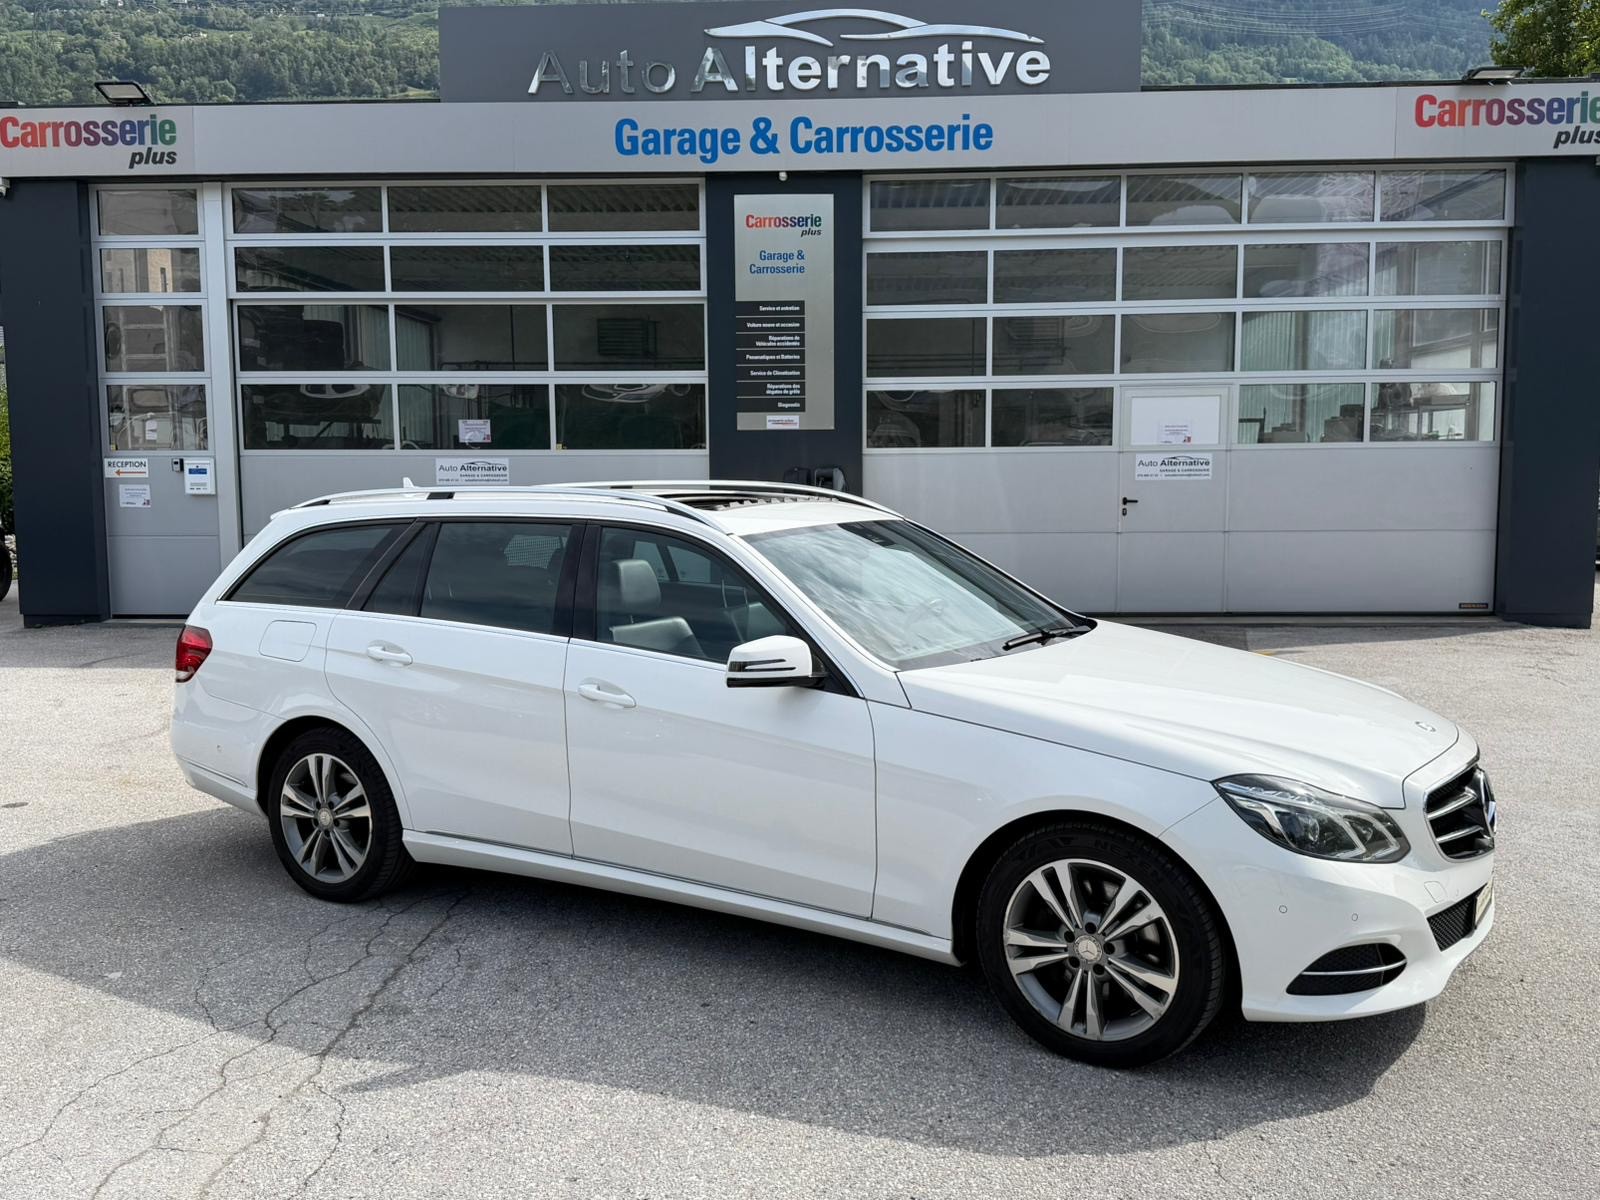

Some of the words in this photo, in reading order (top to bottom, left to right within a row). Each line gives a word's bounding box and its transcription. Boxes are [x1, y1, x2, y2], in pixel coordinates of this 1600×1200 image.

[527, 49, 676, 95] Auto
[690, 40, 1051, 92] Alternative
[0, 114, 177, 148] Carrosserie
[615, 118, 742, 164] Garage
[750, 117, 780, 154] &
[789, 113, 994, 155] Carrosserie
[128, 147, 178, 169] plus
[746, 214, 822, 228] Carrosserie
[801, 228, 822, 237] plus
[759, 250, 794, 262] Garage
[797, 250, 805, 260] &
[749, 263, 805, 274] Carrosserie
[107, 460, 146, 468] RECEPTION
